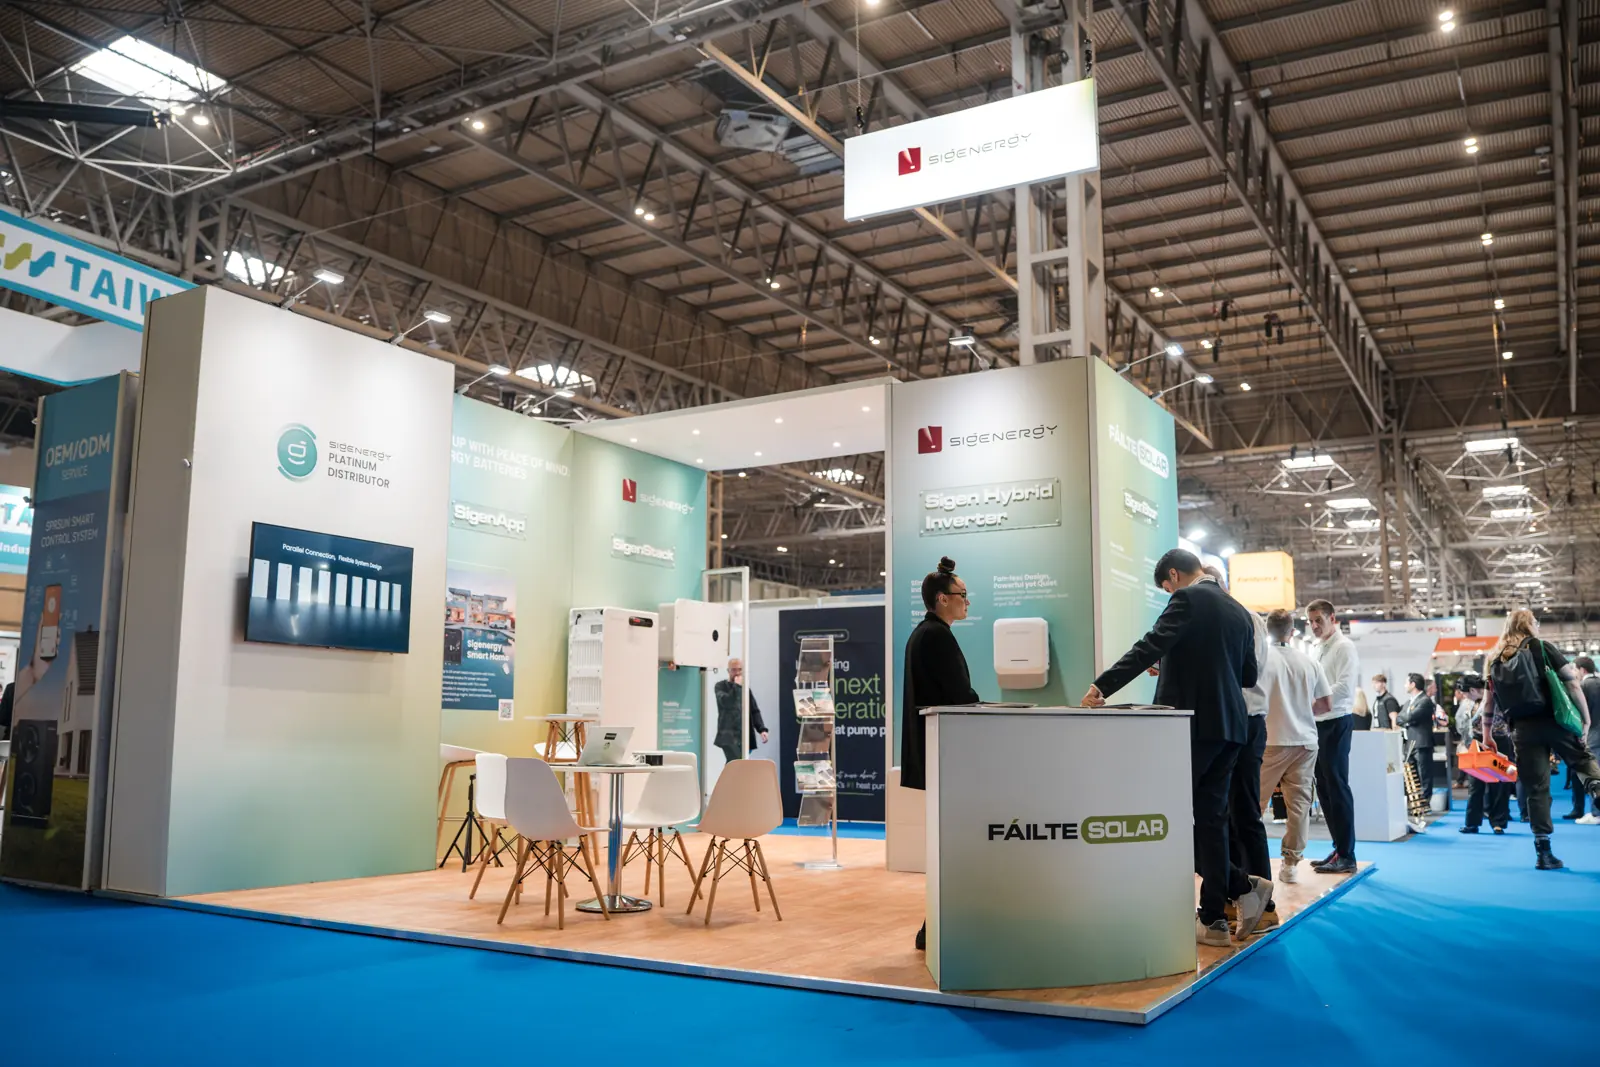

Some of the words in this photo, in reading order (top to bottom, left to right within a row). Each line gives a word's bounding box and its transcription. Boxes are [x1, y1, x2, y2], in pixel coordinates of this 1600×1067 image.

[928, 132, 1032, 165] SIGENERGY
[64, 255, 173, 317] TAI
[949, 424, 1058, 447] SIGENERGY
[45, 432, 112, 467] OEM/ODM
[468, 439, 495, 457] WITH
[496, 448, 530, 467] PEACE
[530, 457, 544, 469] OF
[61, 465, 89, 480] SERVICE
[328, 452, 378, 471] PLATINUM
[473, 456, 527, 480] BATTERIES
[328, 467, 391, 489] DISTRIBUTOR
[925, 490, 980, 511] Sigen
[983, 482, 1054, 507] Hybrid
[71, 513, 96, 528] SMART
[453, 504, 526, 533] SigenApp
[925, 511, 1009, 531] Inverter
[41, 532, 71, 548] CONTROL
[72, 528, 99, 544] SYSTEM
[282, 543, 304, 554] Parallel
[338, 554, 355, 564] Flexible
[355, 558, 369, 567] System
[369, 562, 383, 571] Design
[1037, 579, 1058, 588] Quiet
[466, 651, 489, 660] Smart
[489, 653, 510, 662] Home
[467, 640, 503, 652] Sigenergy
[835, 673, 881, 695] next
[847, 726, 878, 738] pump
[988, 818, 1078, 841] FÁILTE
[1088, 819, 1164, 839] SOLAR
